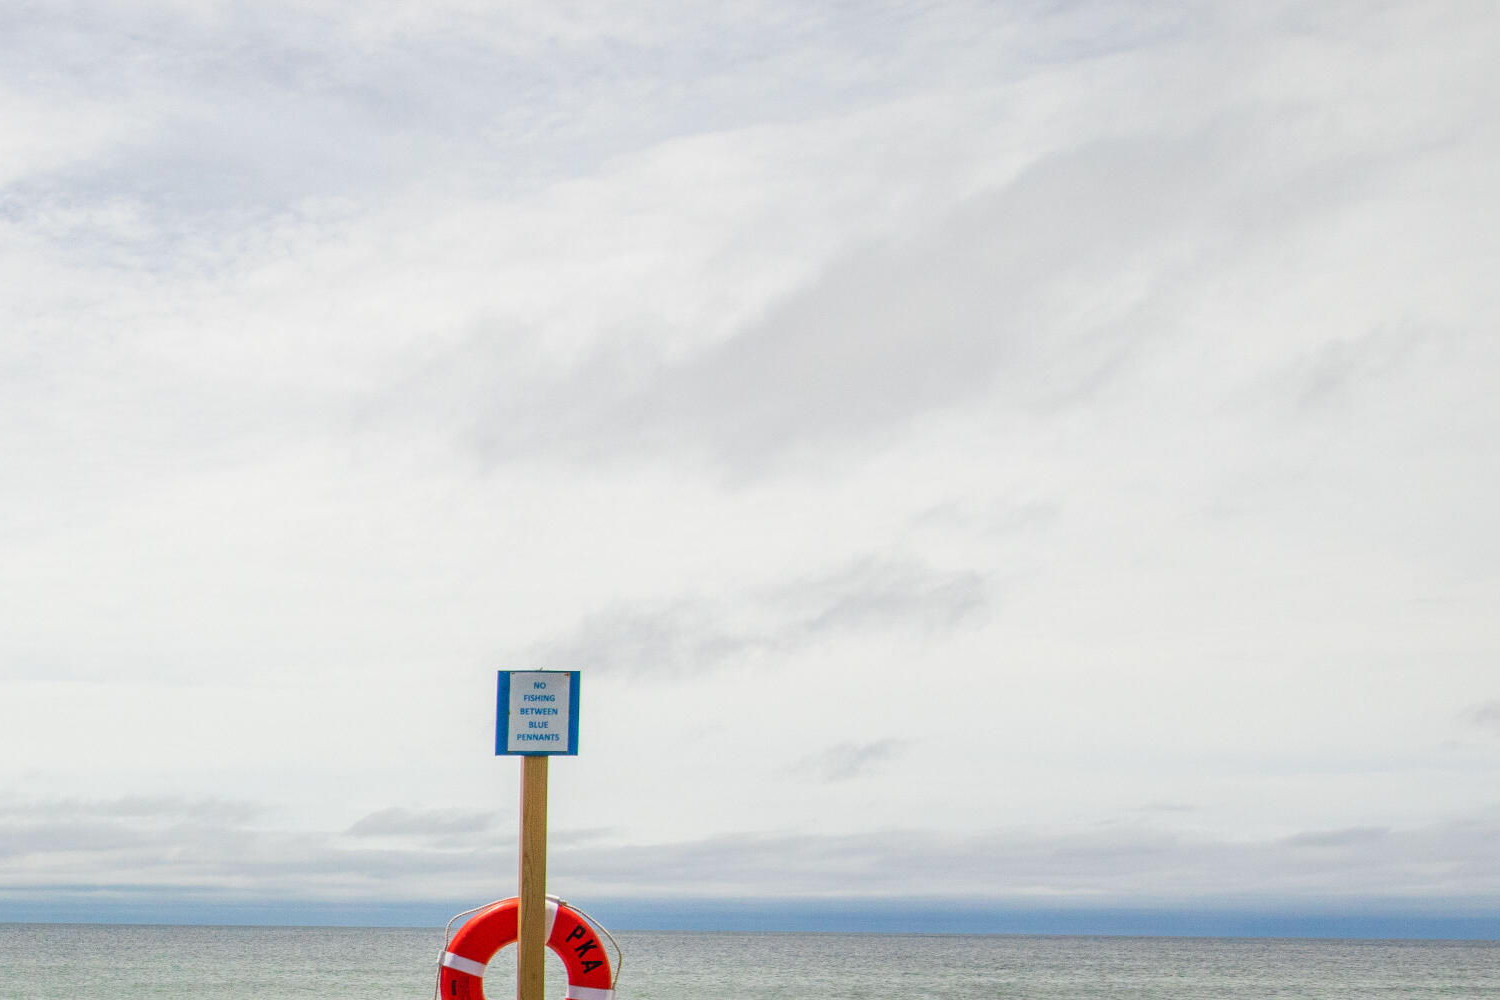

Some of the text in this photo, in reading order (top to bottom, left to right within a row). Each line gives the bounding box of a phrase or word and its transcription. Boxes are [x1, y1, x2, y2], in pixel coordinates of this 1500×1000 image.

[533, 682, 547, 690] NO
[523, 694, 556, 702] FISHING
[519, 707, 558, 715] BETWEEN
[528, 721, 549, 729] BLUE
[516, 733, 560, 741] PENNANTS
[565, 925, 603, 974] PKA
